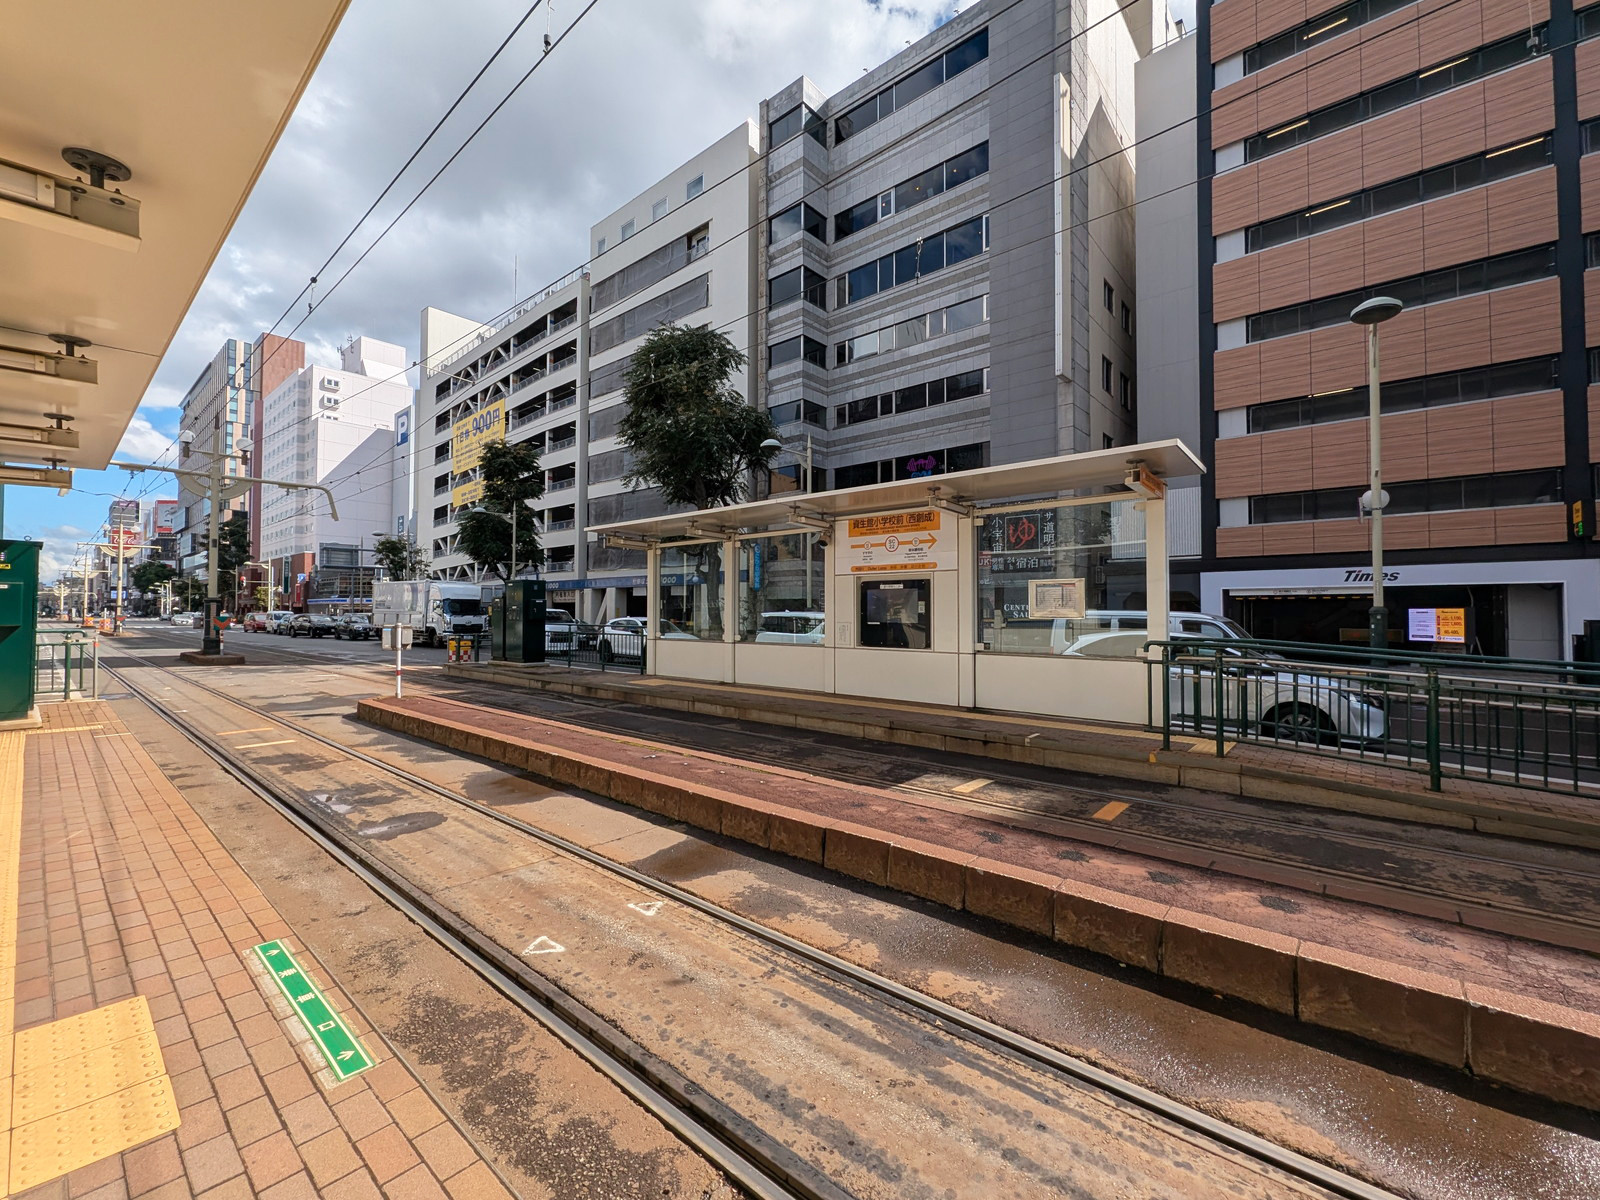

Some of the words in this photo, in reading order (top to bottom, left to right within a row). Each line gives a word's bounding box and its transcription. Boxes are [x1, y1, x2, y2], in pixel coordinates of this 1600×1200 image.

[398, 414, 408, 443] P
[472, 408, 500, 437] 900円
[1009, 517, 1036, 549] ゆ
[1016, 556, 1039, 569] 宿泊
